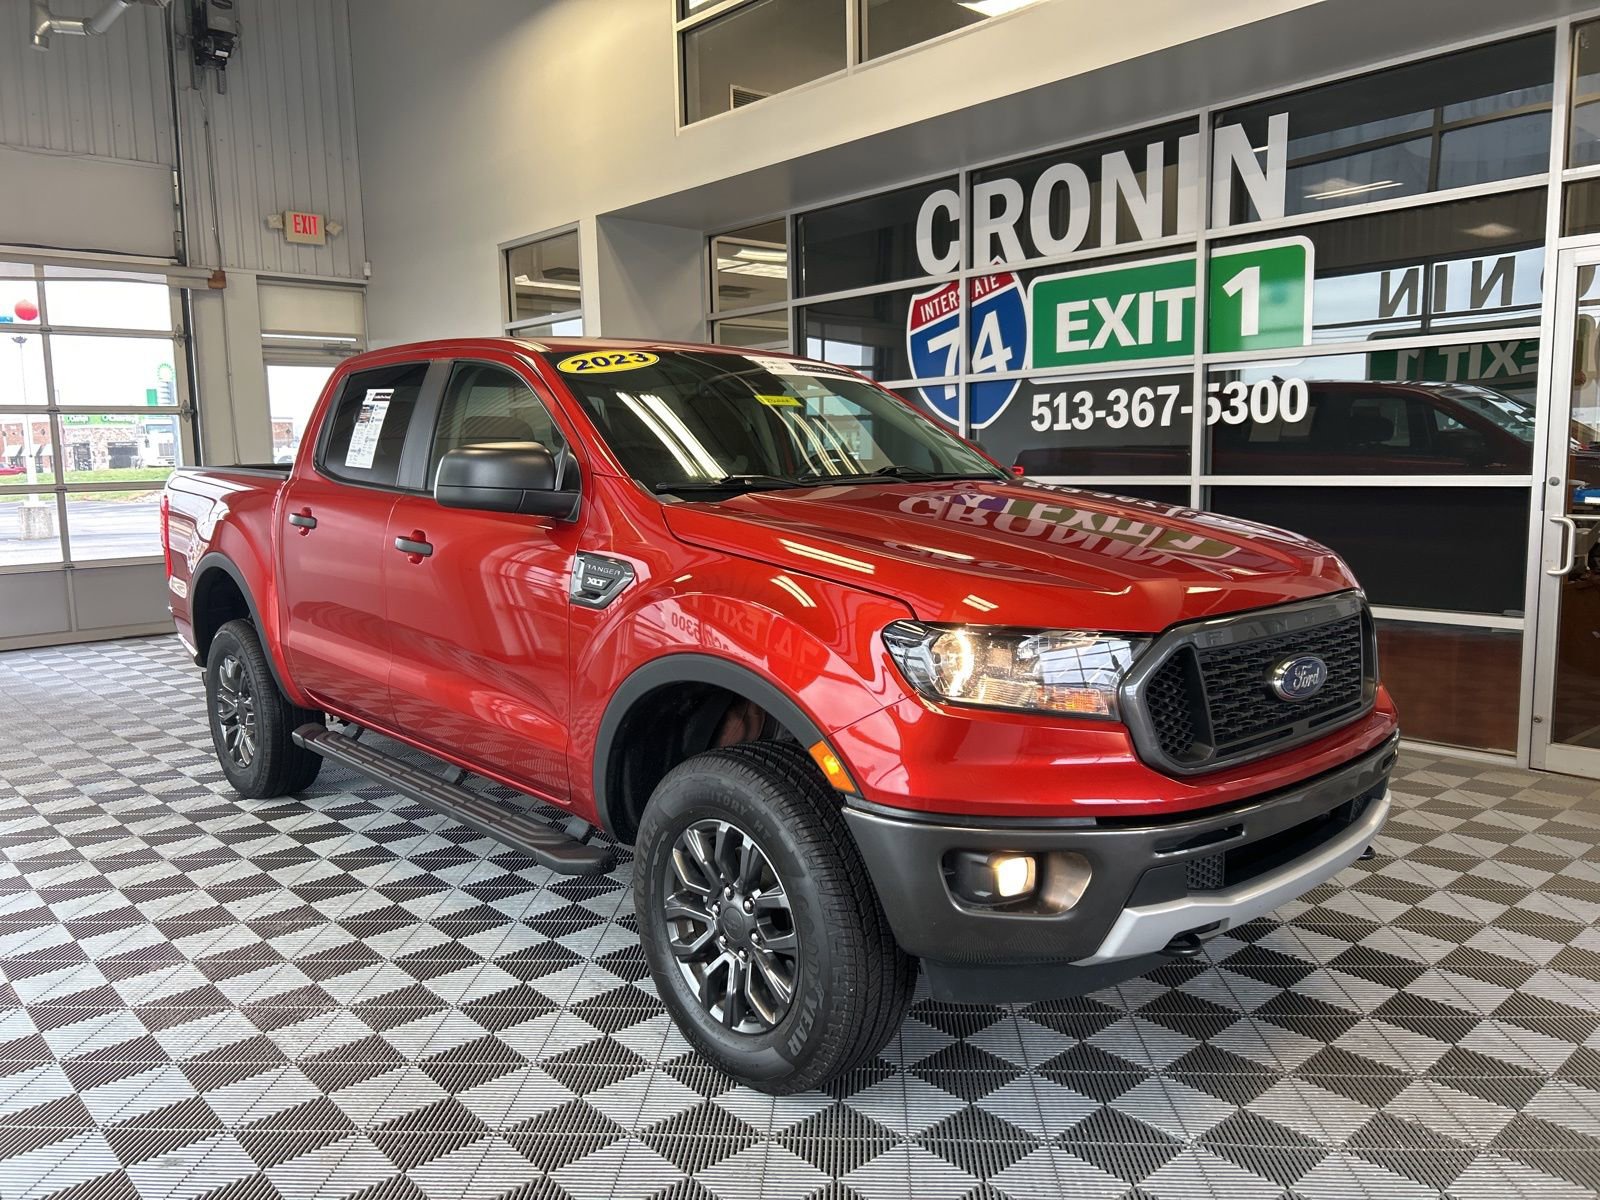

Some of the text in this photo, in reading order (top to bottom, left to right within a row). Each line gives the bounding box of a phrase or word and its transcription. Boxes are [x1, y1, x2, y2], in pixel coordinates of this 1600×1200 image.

[916, 112, 1290, 276] CRONIN
[292, 213, 318, 237] EXIT
[920, 275, 1000, 323] INTERATE
[1056, 265, 1262, 354] EXIT 1
[570, 352, 650, 372] 2023
[927, 310, 1013, 401] 74
[1030, 377, 1310, 432] 513-367-5300
[586, 576, 607, 587] XLT
[1293, 664, 1321, 691] Ford
